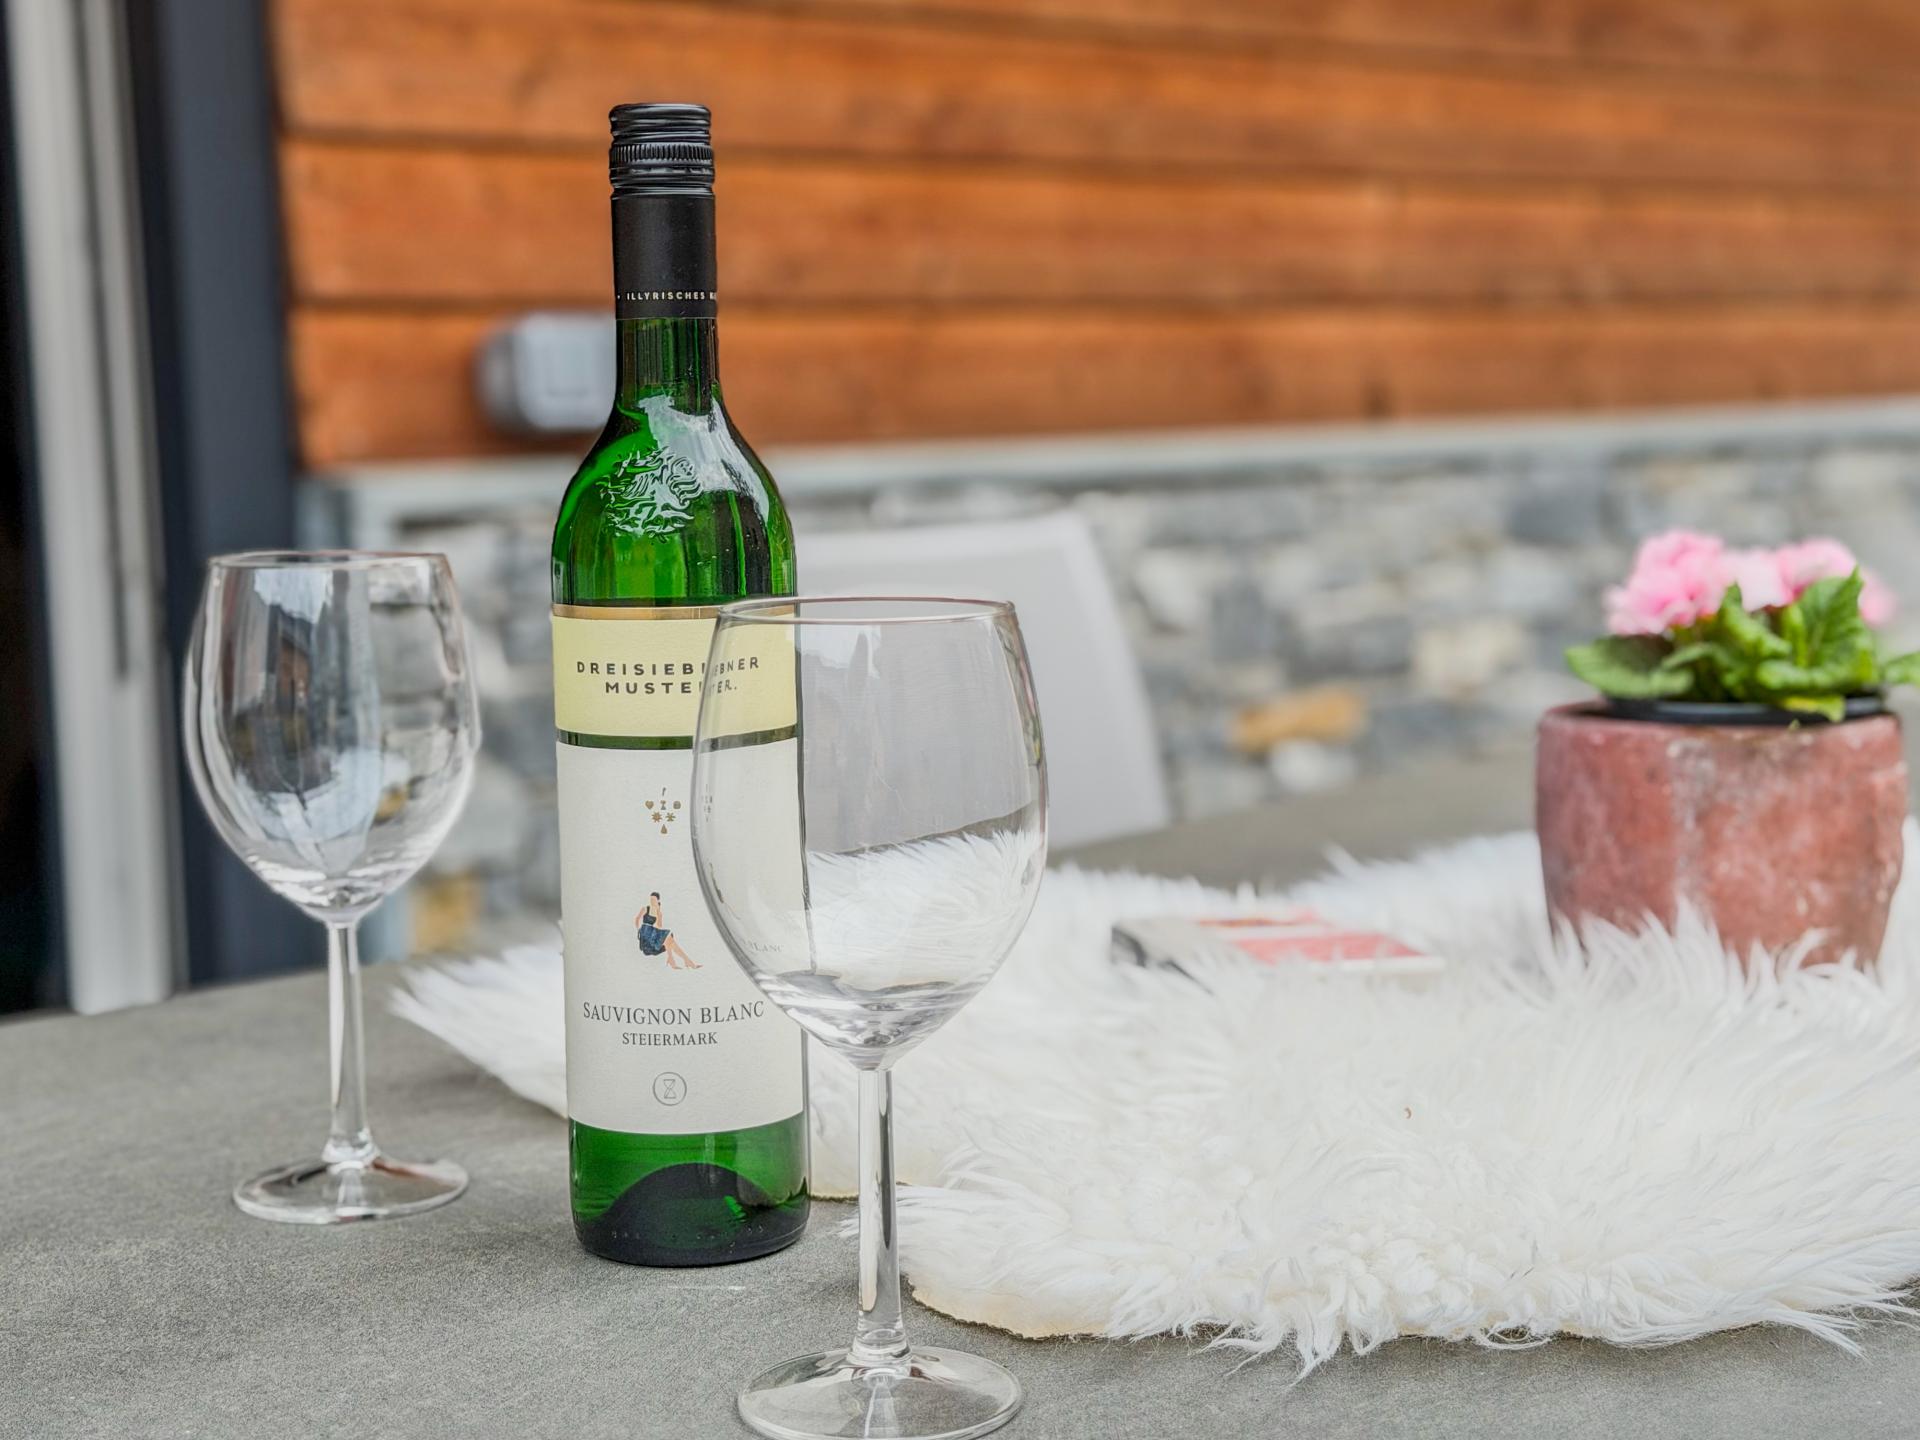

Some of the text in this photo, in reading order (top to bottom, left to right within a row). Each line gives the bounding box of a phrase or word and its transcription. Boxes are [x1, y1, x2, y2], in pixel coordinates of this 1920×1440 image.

[626, 291, 706, 301] ILLYRISCHES
[583, 1000, 765, 1026] SAUVIGNON BLANC
[622, 1031, 718, 1047] STEIERMARK
